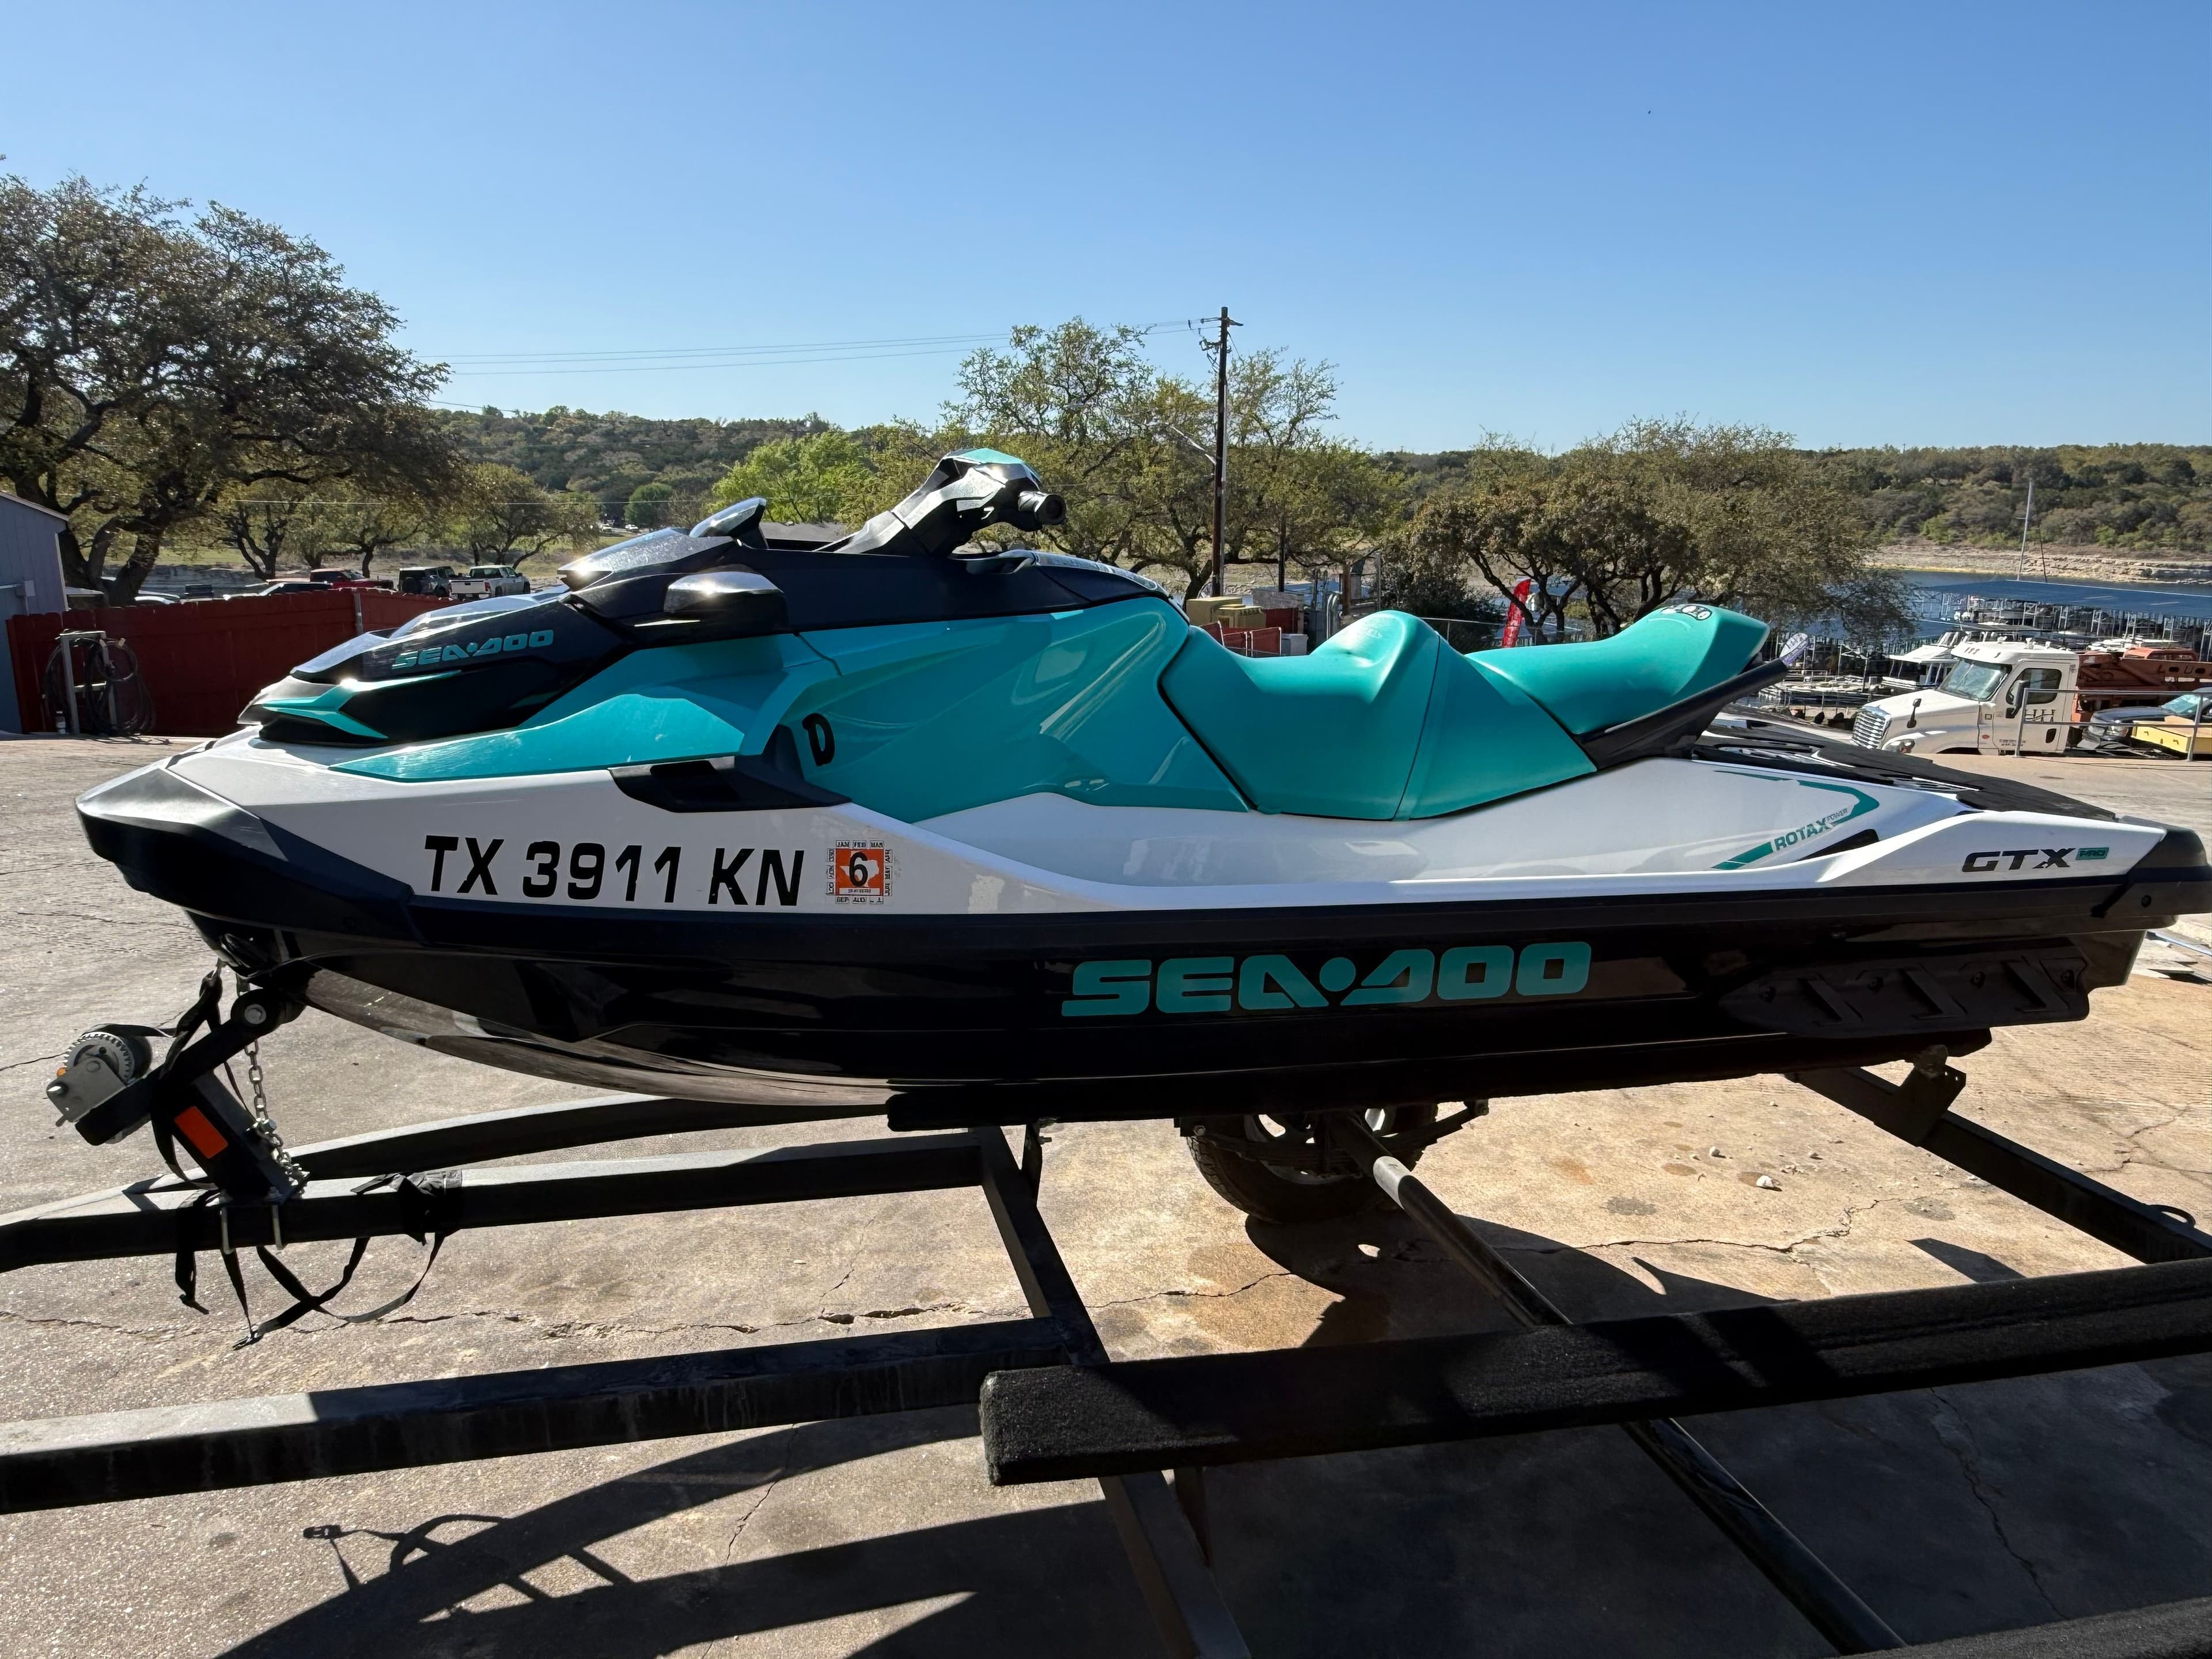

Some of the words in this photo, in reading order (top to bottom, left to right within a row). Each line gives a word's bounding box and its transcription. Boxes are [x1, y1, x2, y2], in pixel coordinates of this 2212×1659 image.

[1774, 817, 1832, 851] ROTAX
[1827, 808, 1848, 821] POWER
[425, 835, 504, 895] TX
[522, 840, 681, 903] 3911
[708, 848, 804, 906] KN
[849, 851, 868, 887] 6
[1961, 848, 2076, 872] GTX
